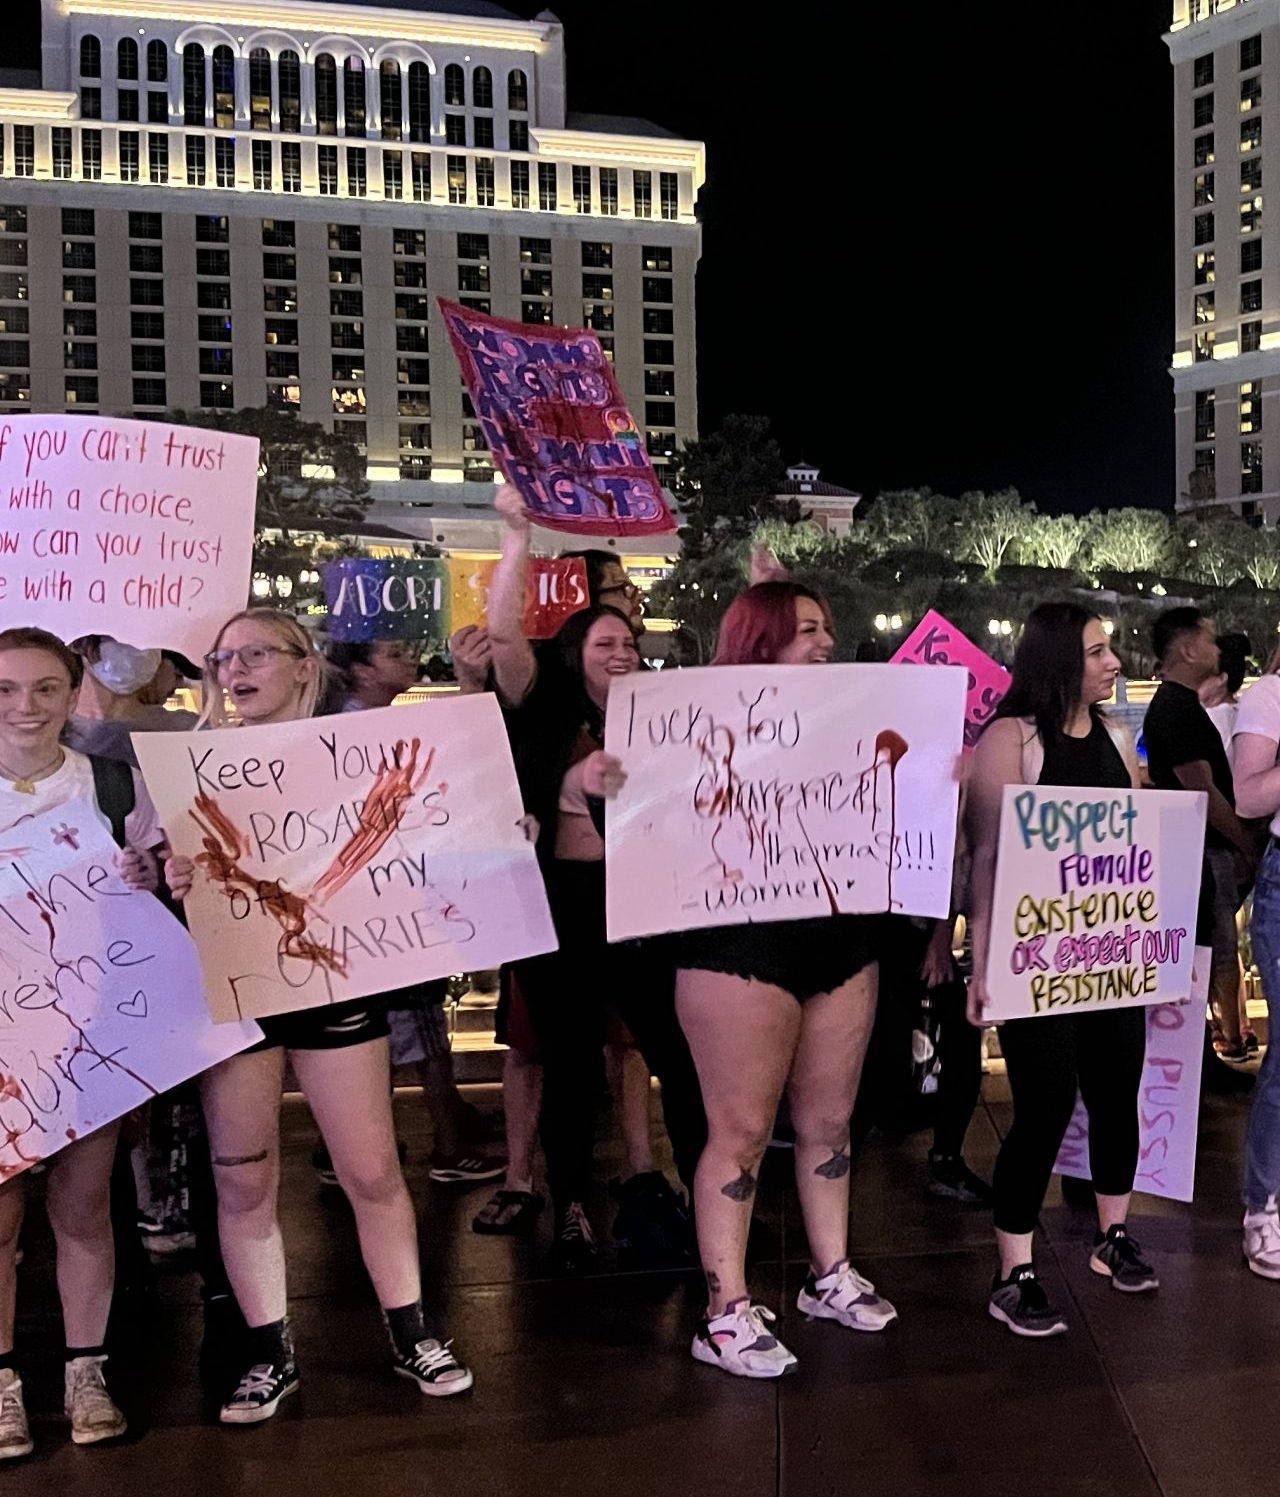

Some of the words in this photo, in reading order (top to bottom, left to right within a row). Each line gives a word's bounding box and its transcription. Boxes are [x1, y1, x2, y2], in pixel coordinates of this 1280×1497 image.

[0, 425, 11, 460] f
[24, 429, 66, 477] you
[164, 432, 226, 470] trust
[9, 480, 52, 510] with
[67, 488, 80, 511] a
[100, 484, 194, 525] choice,
[34, 529, 78, 557] can
[97, 532, 141, 563] you
[160, 532, 222, 566] trust
[25, 569, 71, 602] with
[89, 580, 104, 604] a
[124, 573, 204, 611] child?
[738, 687, 801, 749] You
[188, 746, 285, 794] Keep
[1015, 791, 1138, 855] Respect
[367, 852, 427, 897] my
[1060, 845, 1154, 894] Female
[1015, 890, 1158, 938] existence
[1054, 925, 1140, 973] expect
[1142, 928, 1187, 966] our
[1031, 966, 1157, 1013] RESISTANCE
[1137, 1058, 1184, 1188] PUSSY
